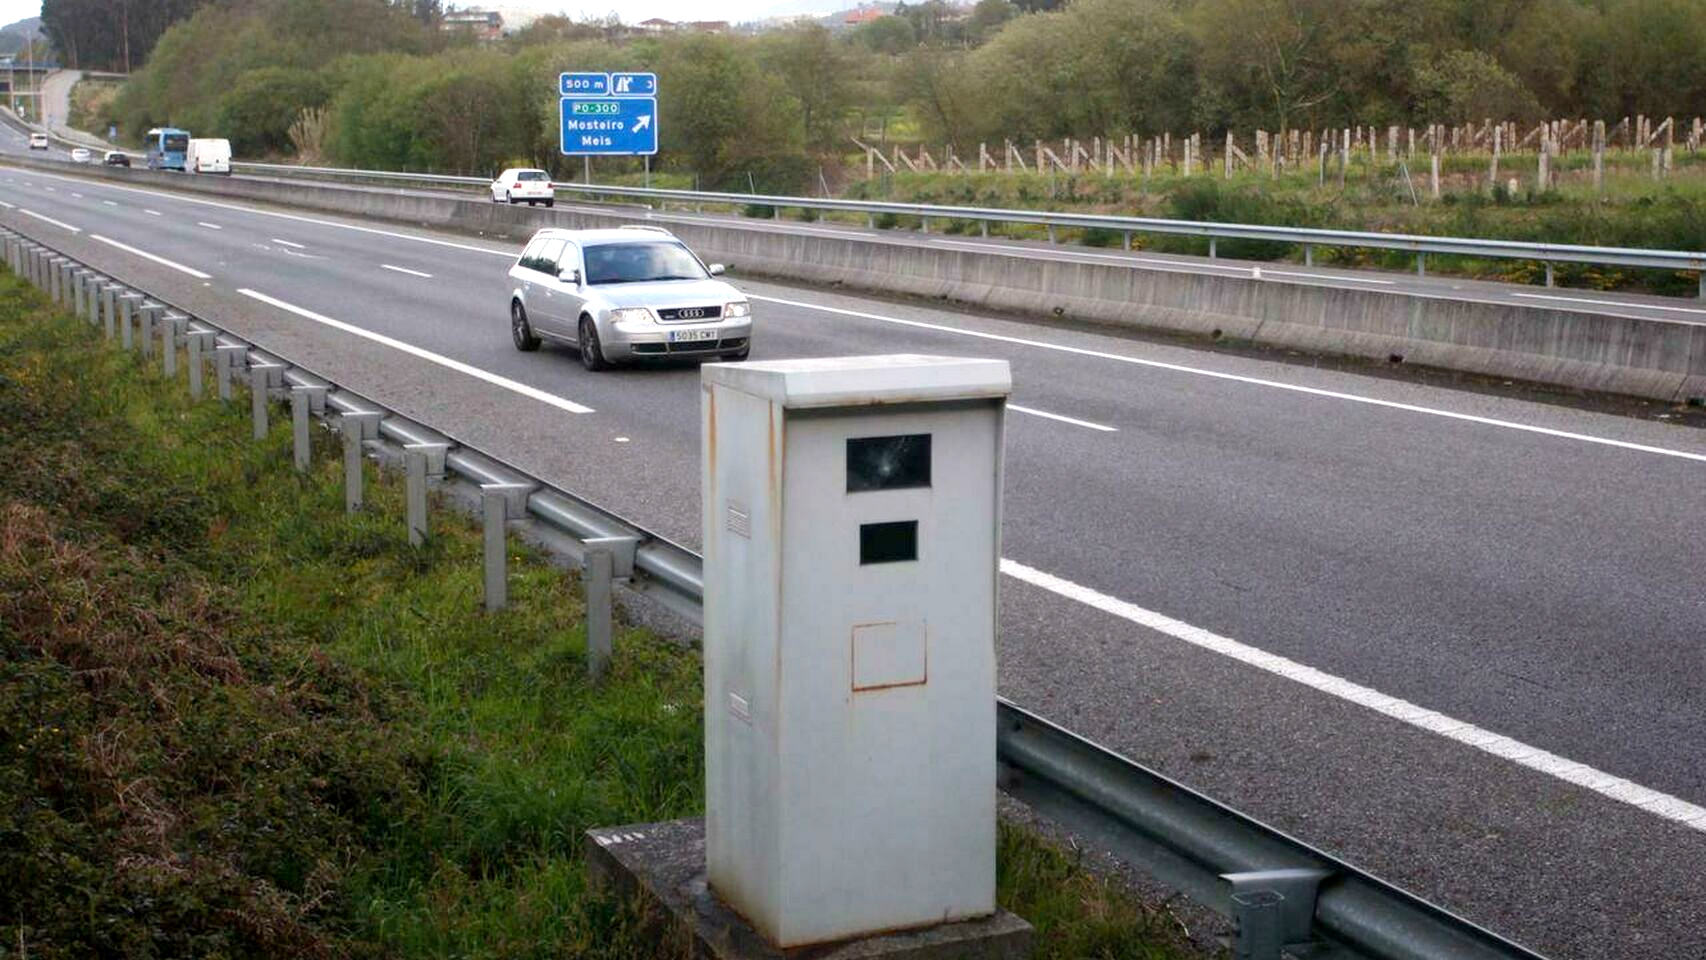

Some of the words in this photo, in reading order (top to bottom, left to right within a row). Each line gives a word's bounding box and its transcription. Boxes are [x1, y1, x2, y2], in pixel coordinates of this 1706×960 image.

[566, 80, 589, 89] 500
[594, 81, 604, 89] m
[646, 80, 653, 89] 3
[574, 104, 618, 112] PO-300
[568, 119, 624, 130] Mosteiro
[581, 136, 612, 146] Meis
